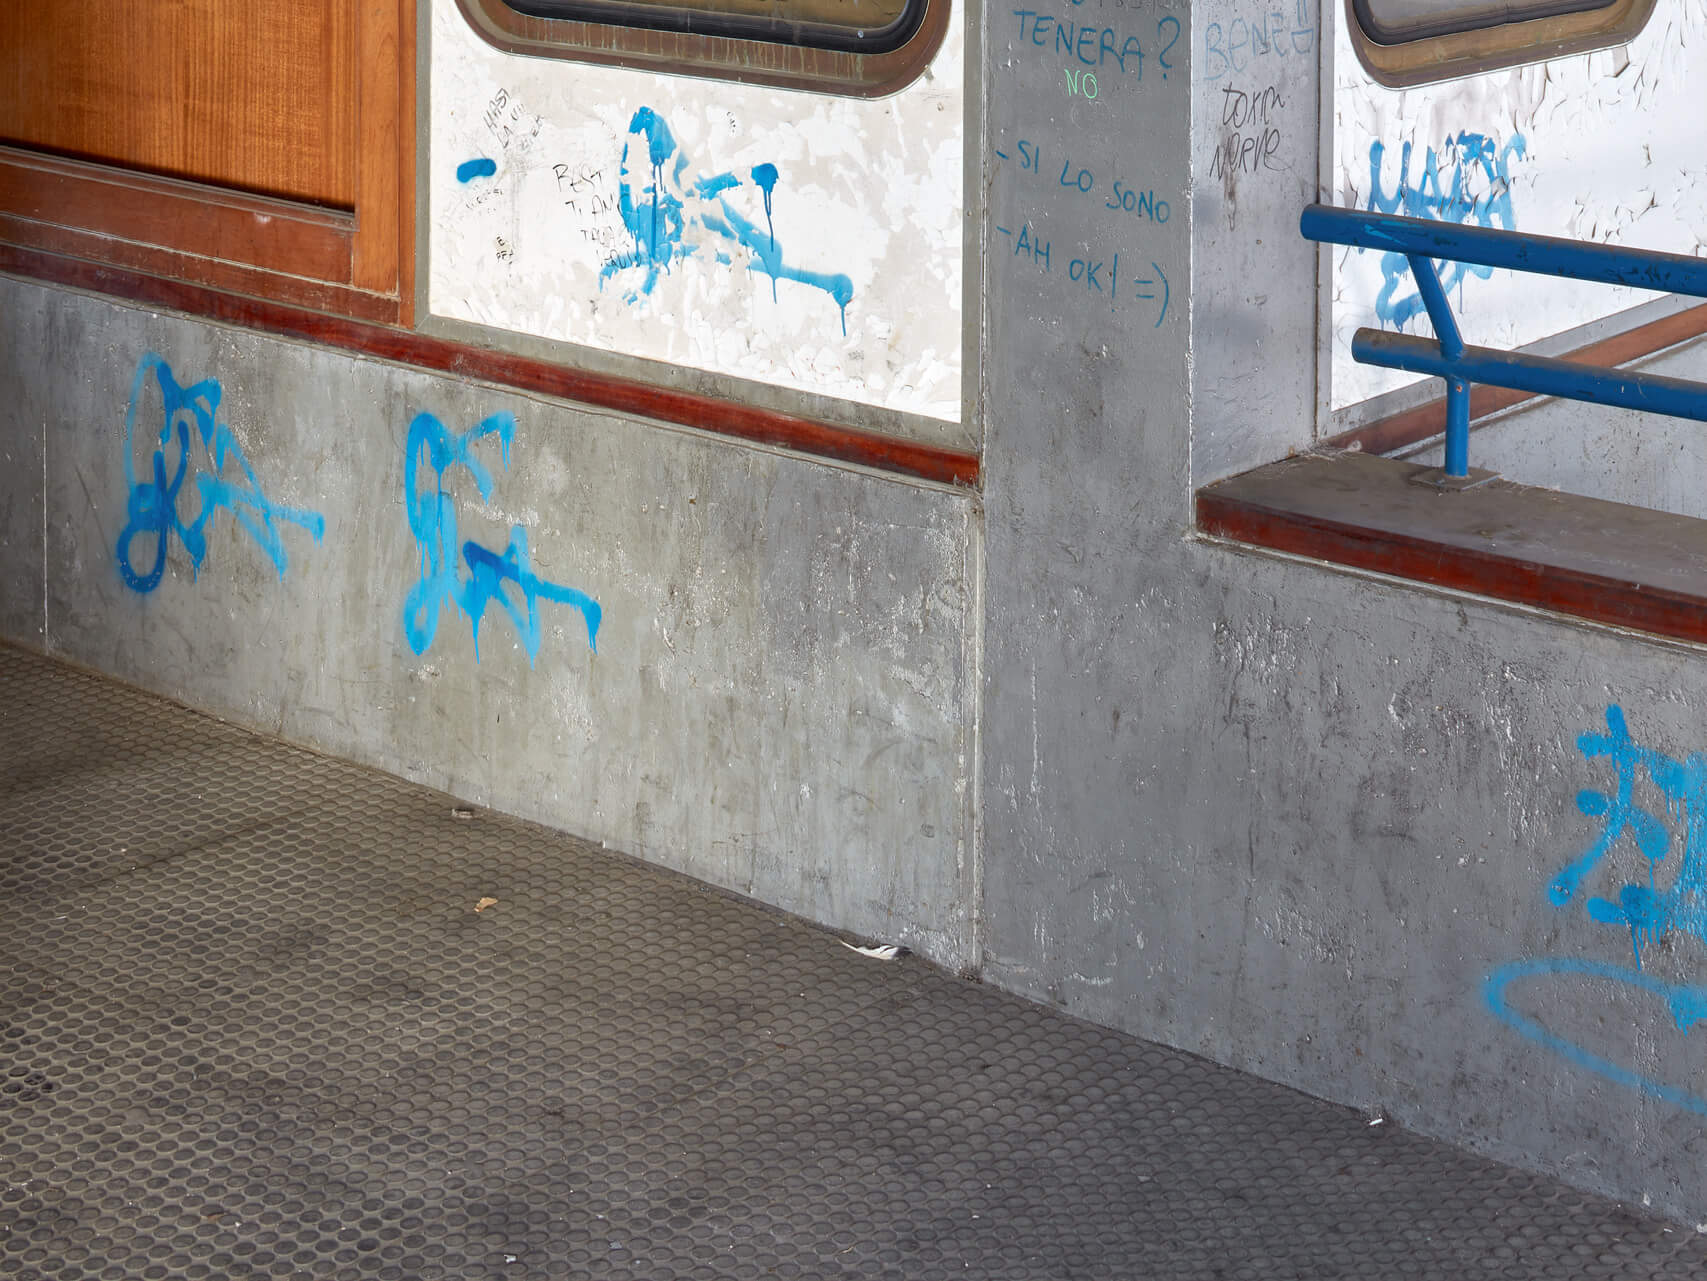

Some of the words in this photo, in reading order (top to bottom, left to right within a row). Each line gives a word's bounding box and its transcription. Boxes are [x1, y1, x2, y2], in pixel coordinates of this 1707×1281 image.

[1064, 68, 1099, 99] NO
[1059, 159, 1094, 193] LO
[1106, 180, 1171, 224] SONO
[1068, 252, 1119, 313] OK!
